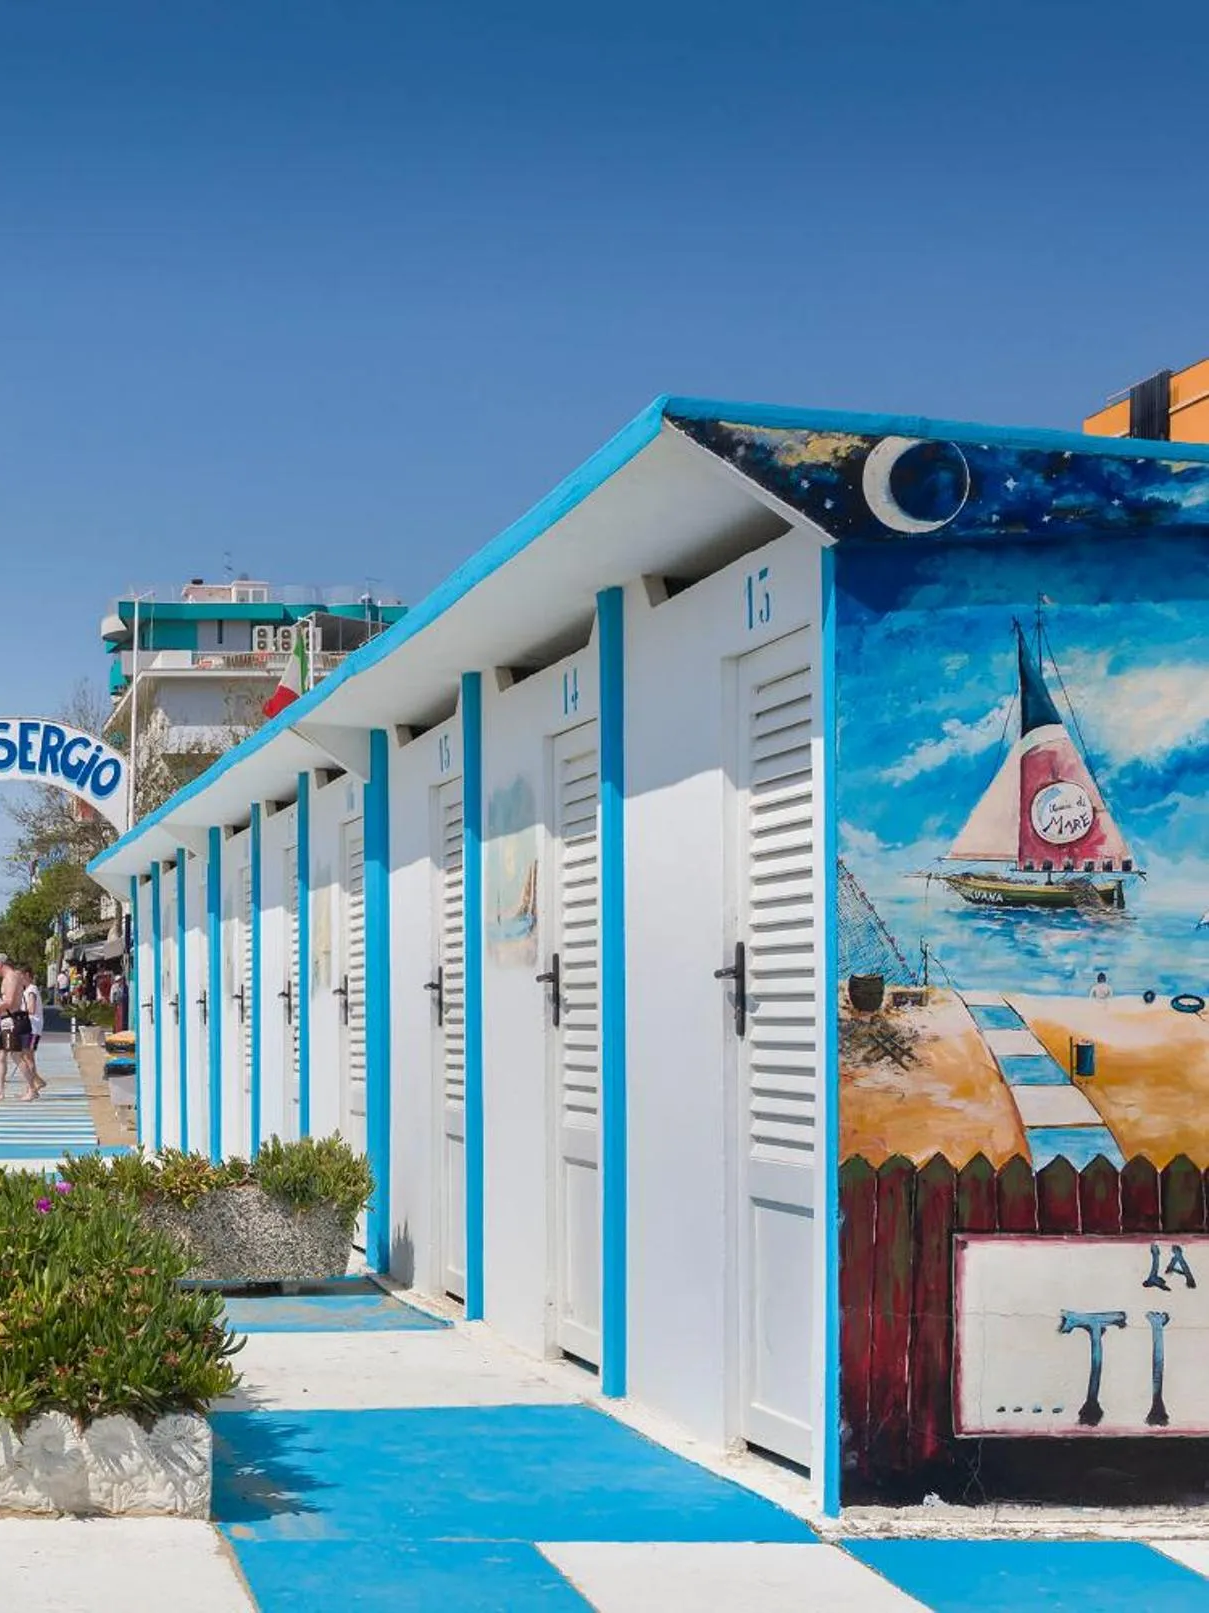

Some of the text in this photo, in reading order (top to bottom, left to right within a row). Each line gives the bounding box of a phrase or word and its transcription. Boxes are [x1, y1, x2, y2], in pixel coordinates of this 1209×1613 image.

[563, 667, 579, 715] 14
[439, 734, 451, 773] 15
[1042, 812, 1091, 835] MARE
[1142, 1243, 1198, 1292] LA
